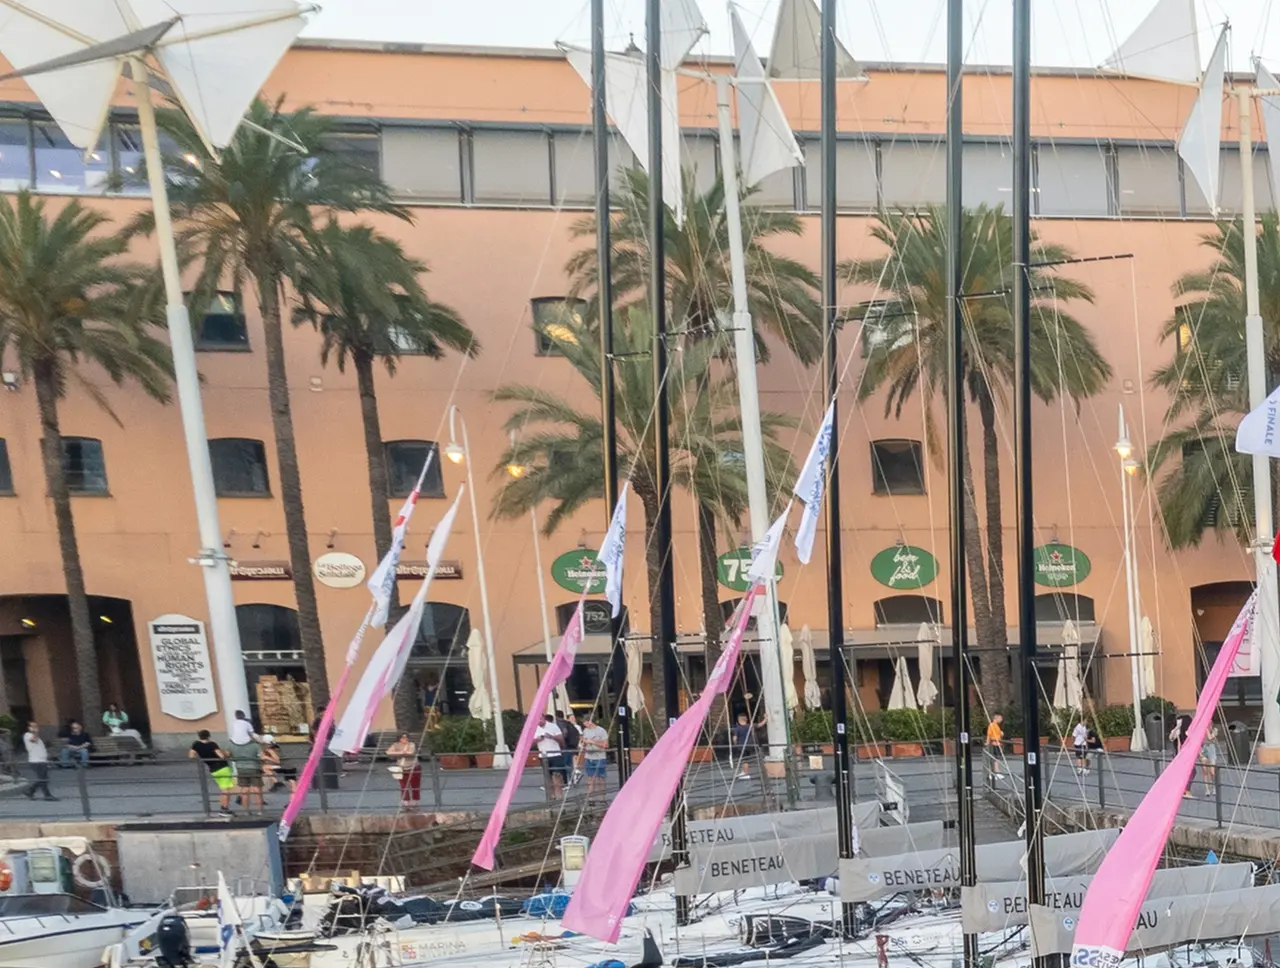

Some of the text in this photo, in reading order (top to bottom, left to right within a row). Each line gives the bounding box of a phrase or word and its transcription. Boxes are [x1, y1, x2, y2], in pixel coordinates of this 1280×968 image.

[1264, 408, 1277, 446] FINALE
[711, 855, 784, 877] BENETEAU
[883, 867, 961, 886] BENETEAU
